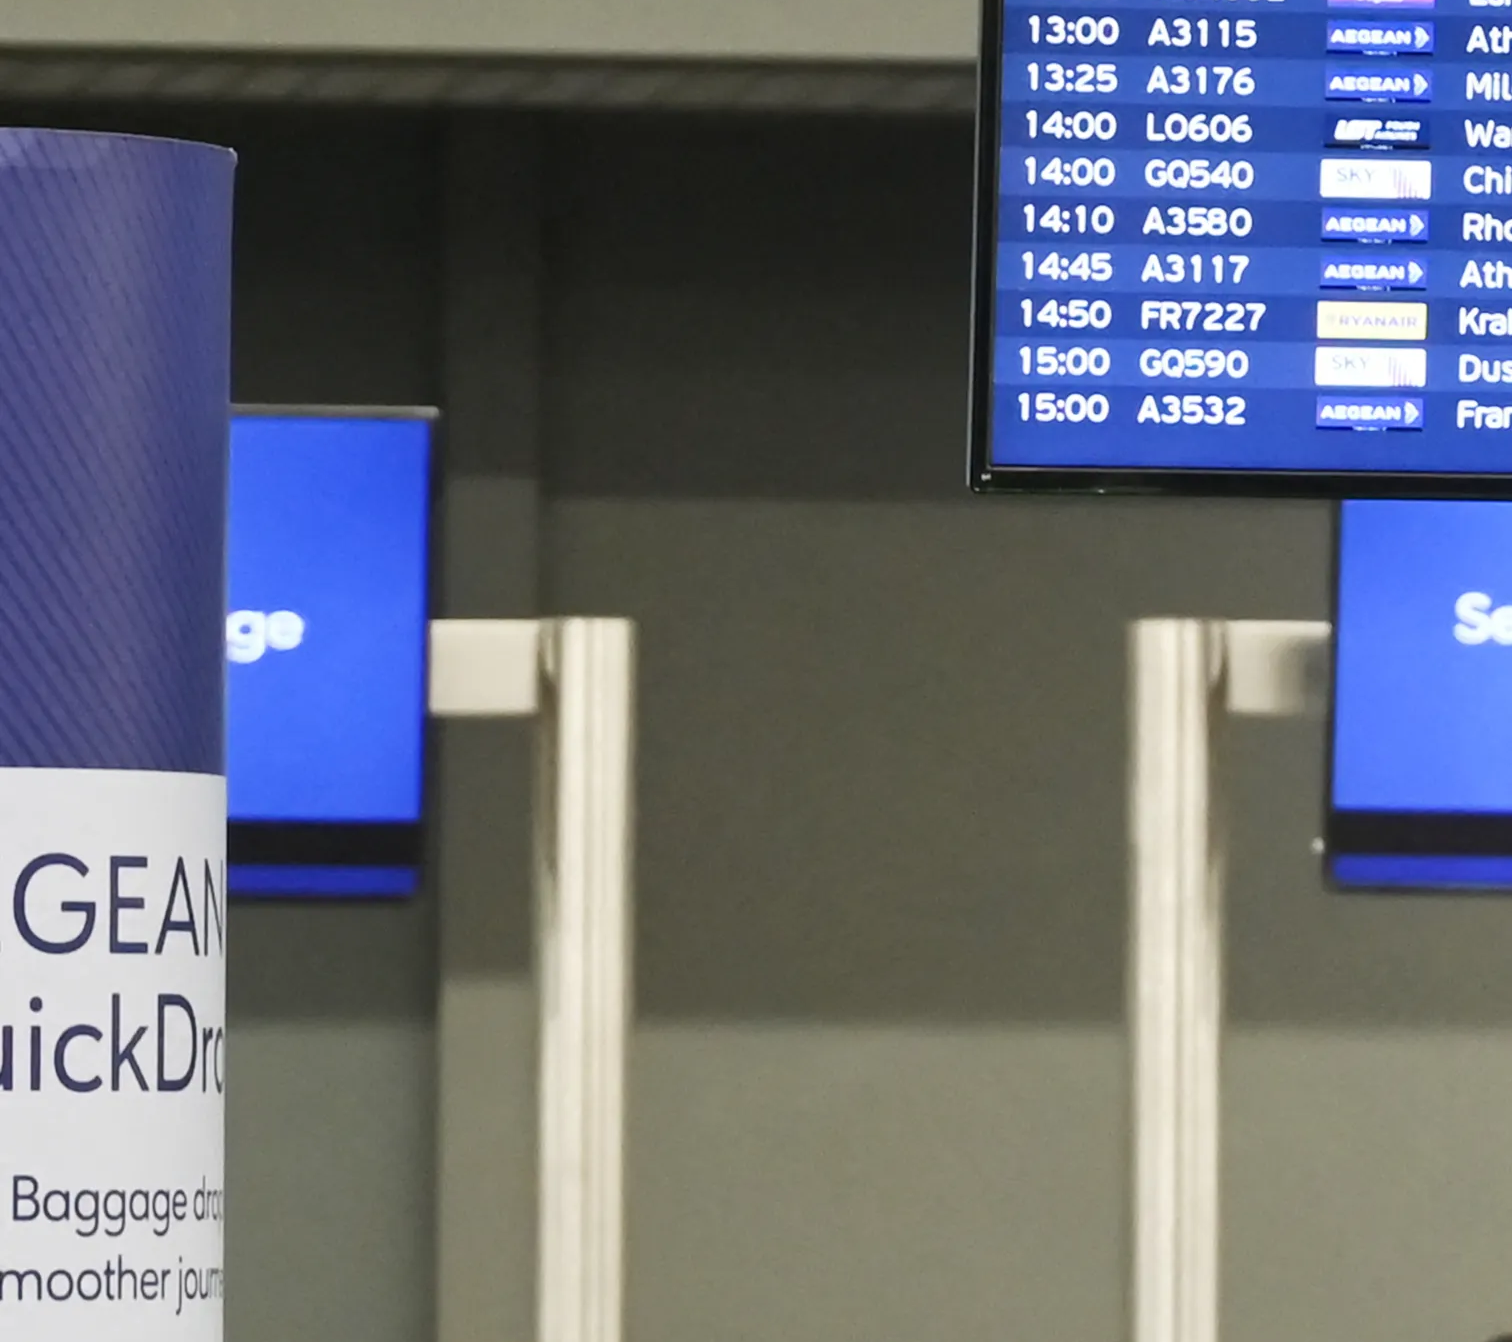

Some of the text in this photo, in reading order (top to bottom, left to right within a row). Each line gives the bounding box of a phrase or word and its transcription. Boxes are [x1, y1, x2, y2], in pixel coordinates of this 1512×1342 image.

[1027, 62, 1118, 93] 13:25
[1146, 65, 1256, 96] A3176
[1329, 75, 1411, 92] AEGEAN
[1025, 109, 1117, 141] 14:00
[1024, 156, 1116, 187] 14:00
[1144, 158, 1255, 190] GQ540
[1019, 345, 1111, 377] 15:00
[1139, 348, 1250, 379] GQ590
[0, 852, 224, 957] GEAN
[12, 1174, 188, 1237] Baggage
